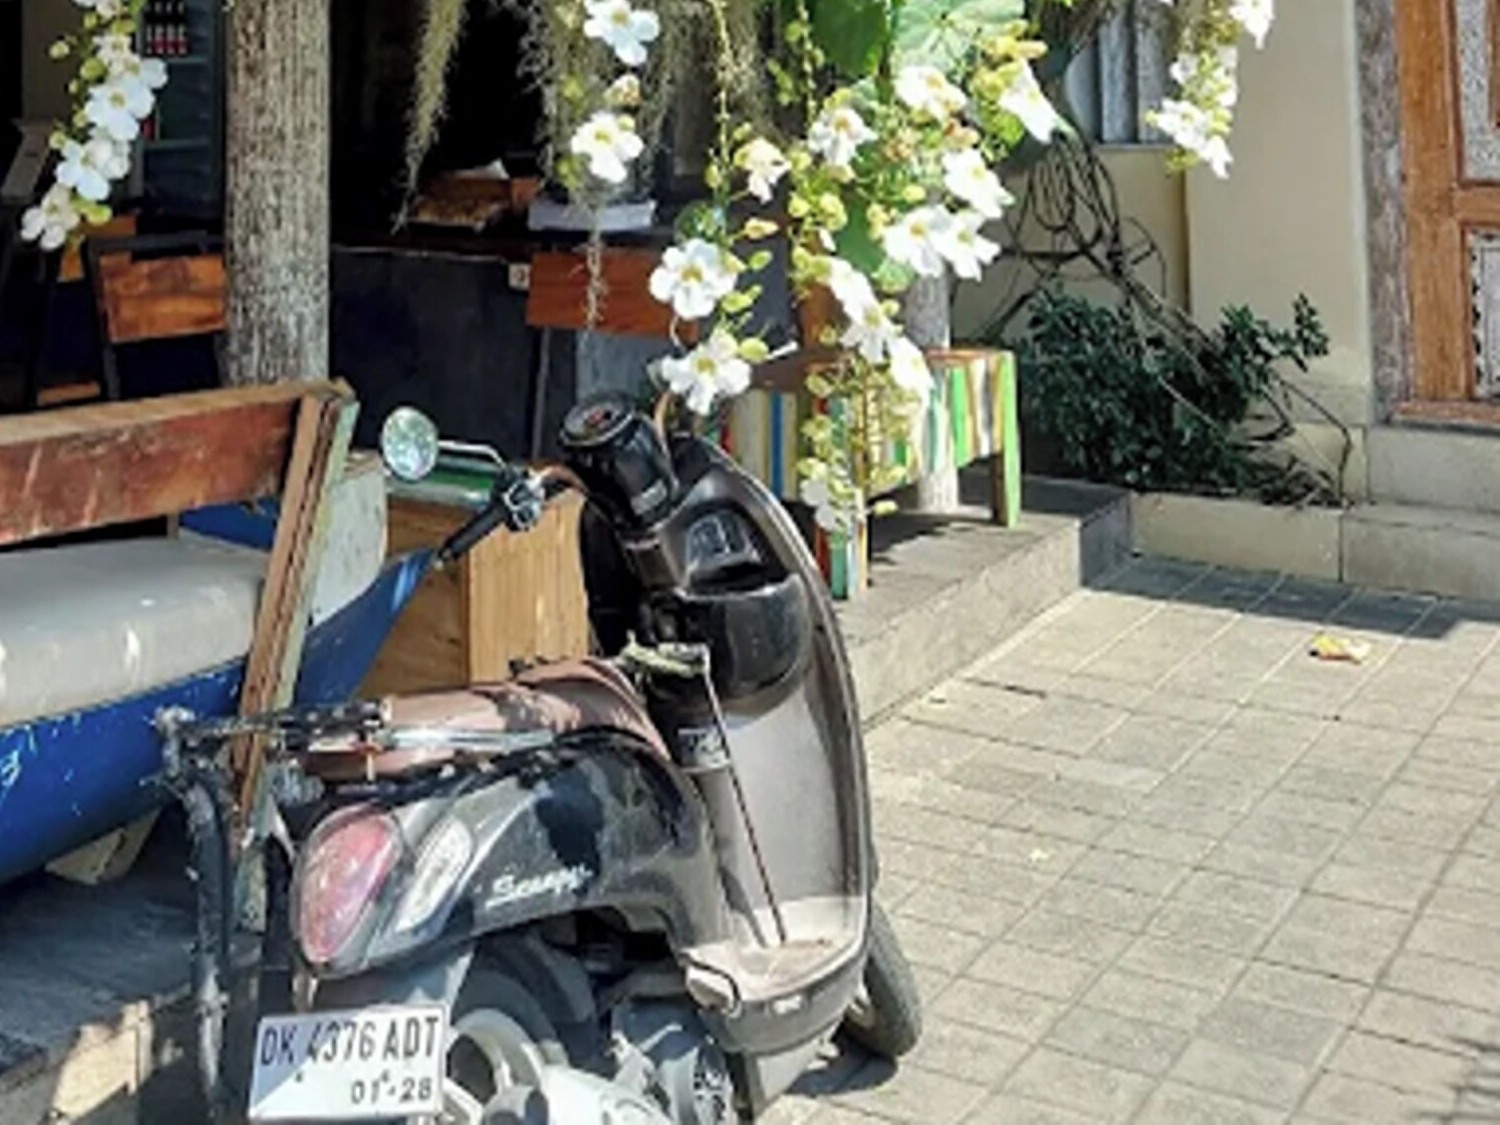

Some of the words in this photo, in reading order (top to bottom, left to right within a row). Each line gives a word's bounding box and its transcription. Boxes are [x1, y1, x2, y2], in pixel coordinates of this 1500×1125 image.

[260, 1024, 297, 1066] DK
[306, 1020, 376, 1063] 4376
[382, 1016, 439, 1058] ADT
